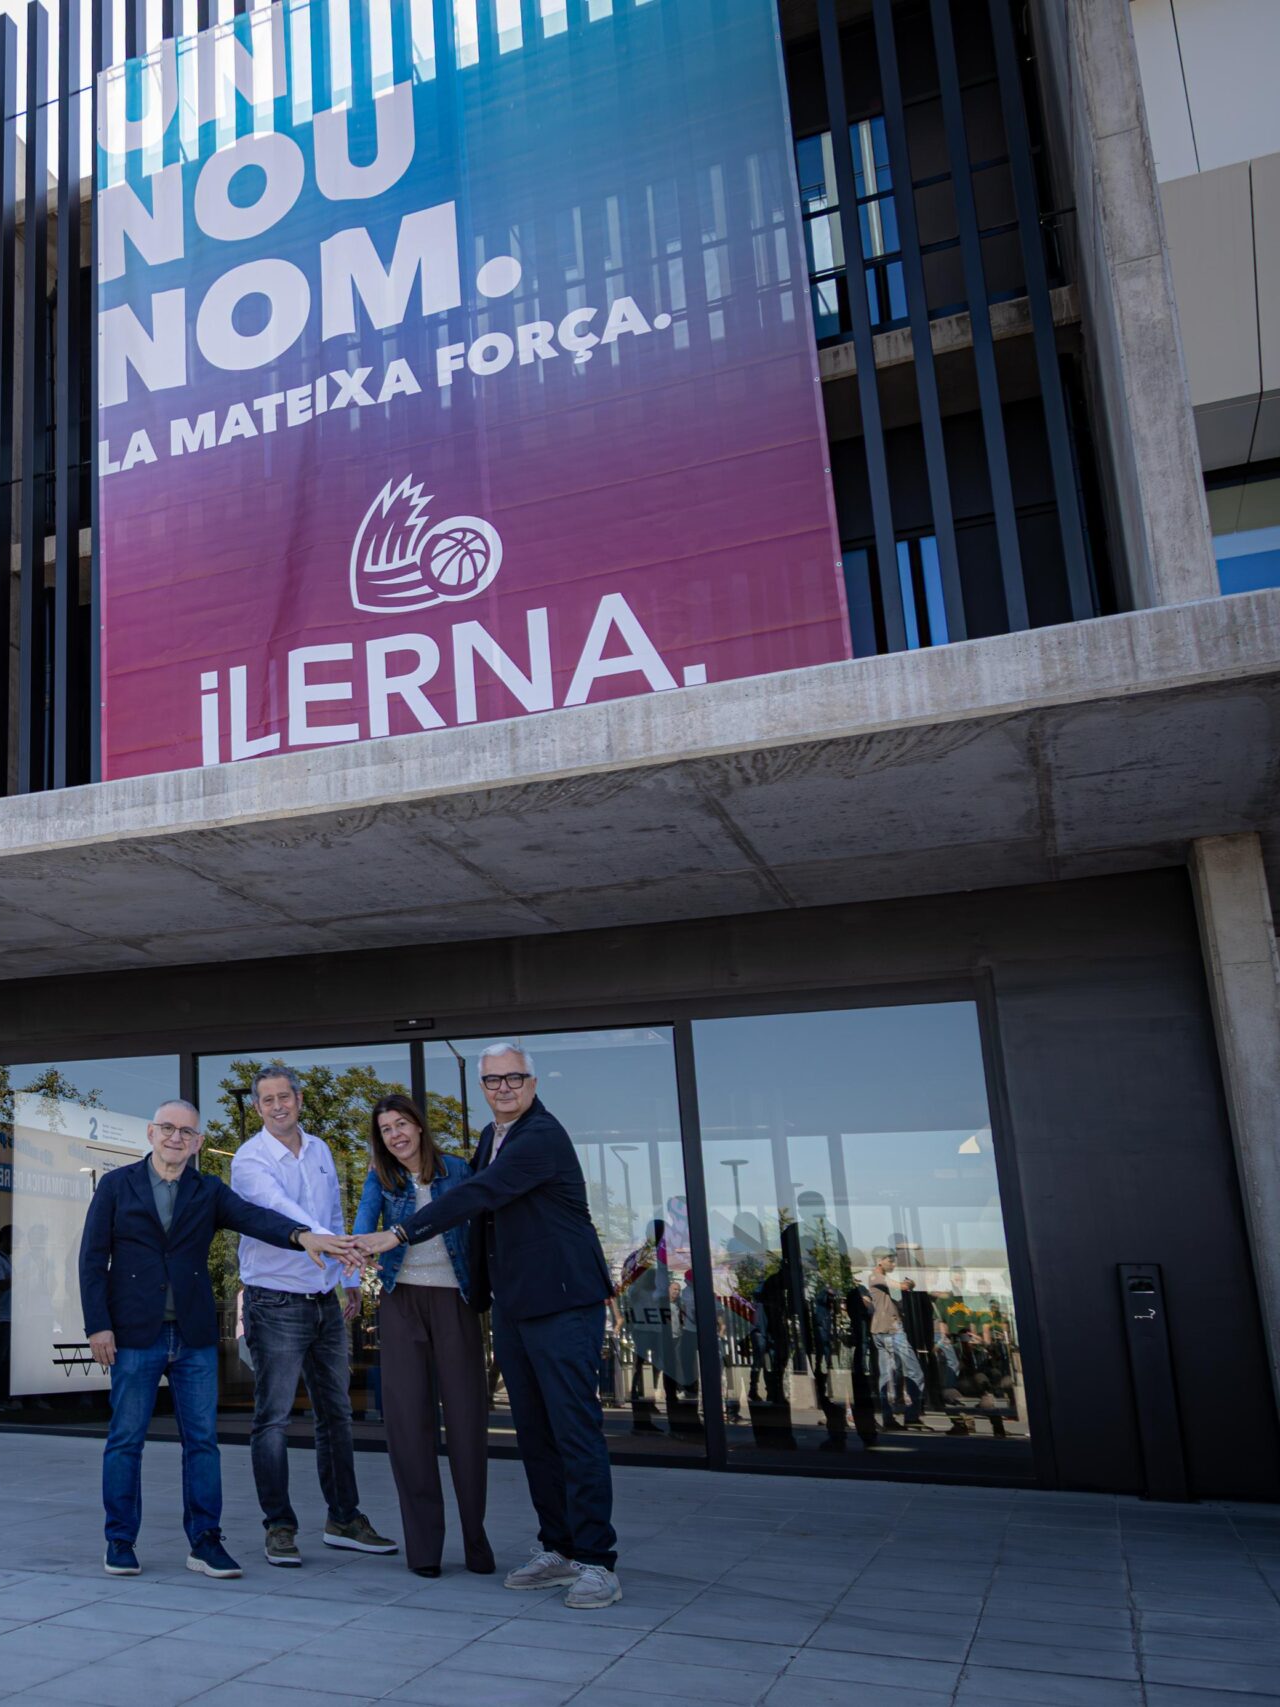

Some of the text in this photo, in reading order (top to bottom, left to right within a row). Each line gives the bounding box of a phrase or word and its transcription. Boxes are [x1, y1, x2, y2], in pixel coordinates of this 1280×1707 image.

[97, 80, 416, 284] NOU
[98, 200, 523, 410] NOM.
[98, 295, 673, 478] LA MATEIXA FORÇA.
